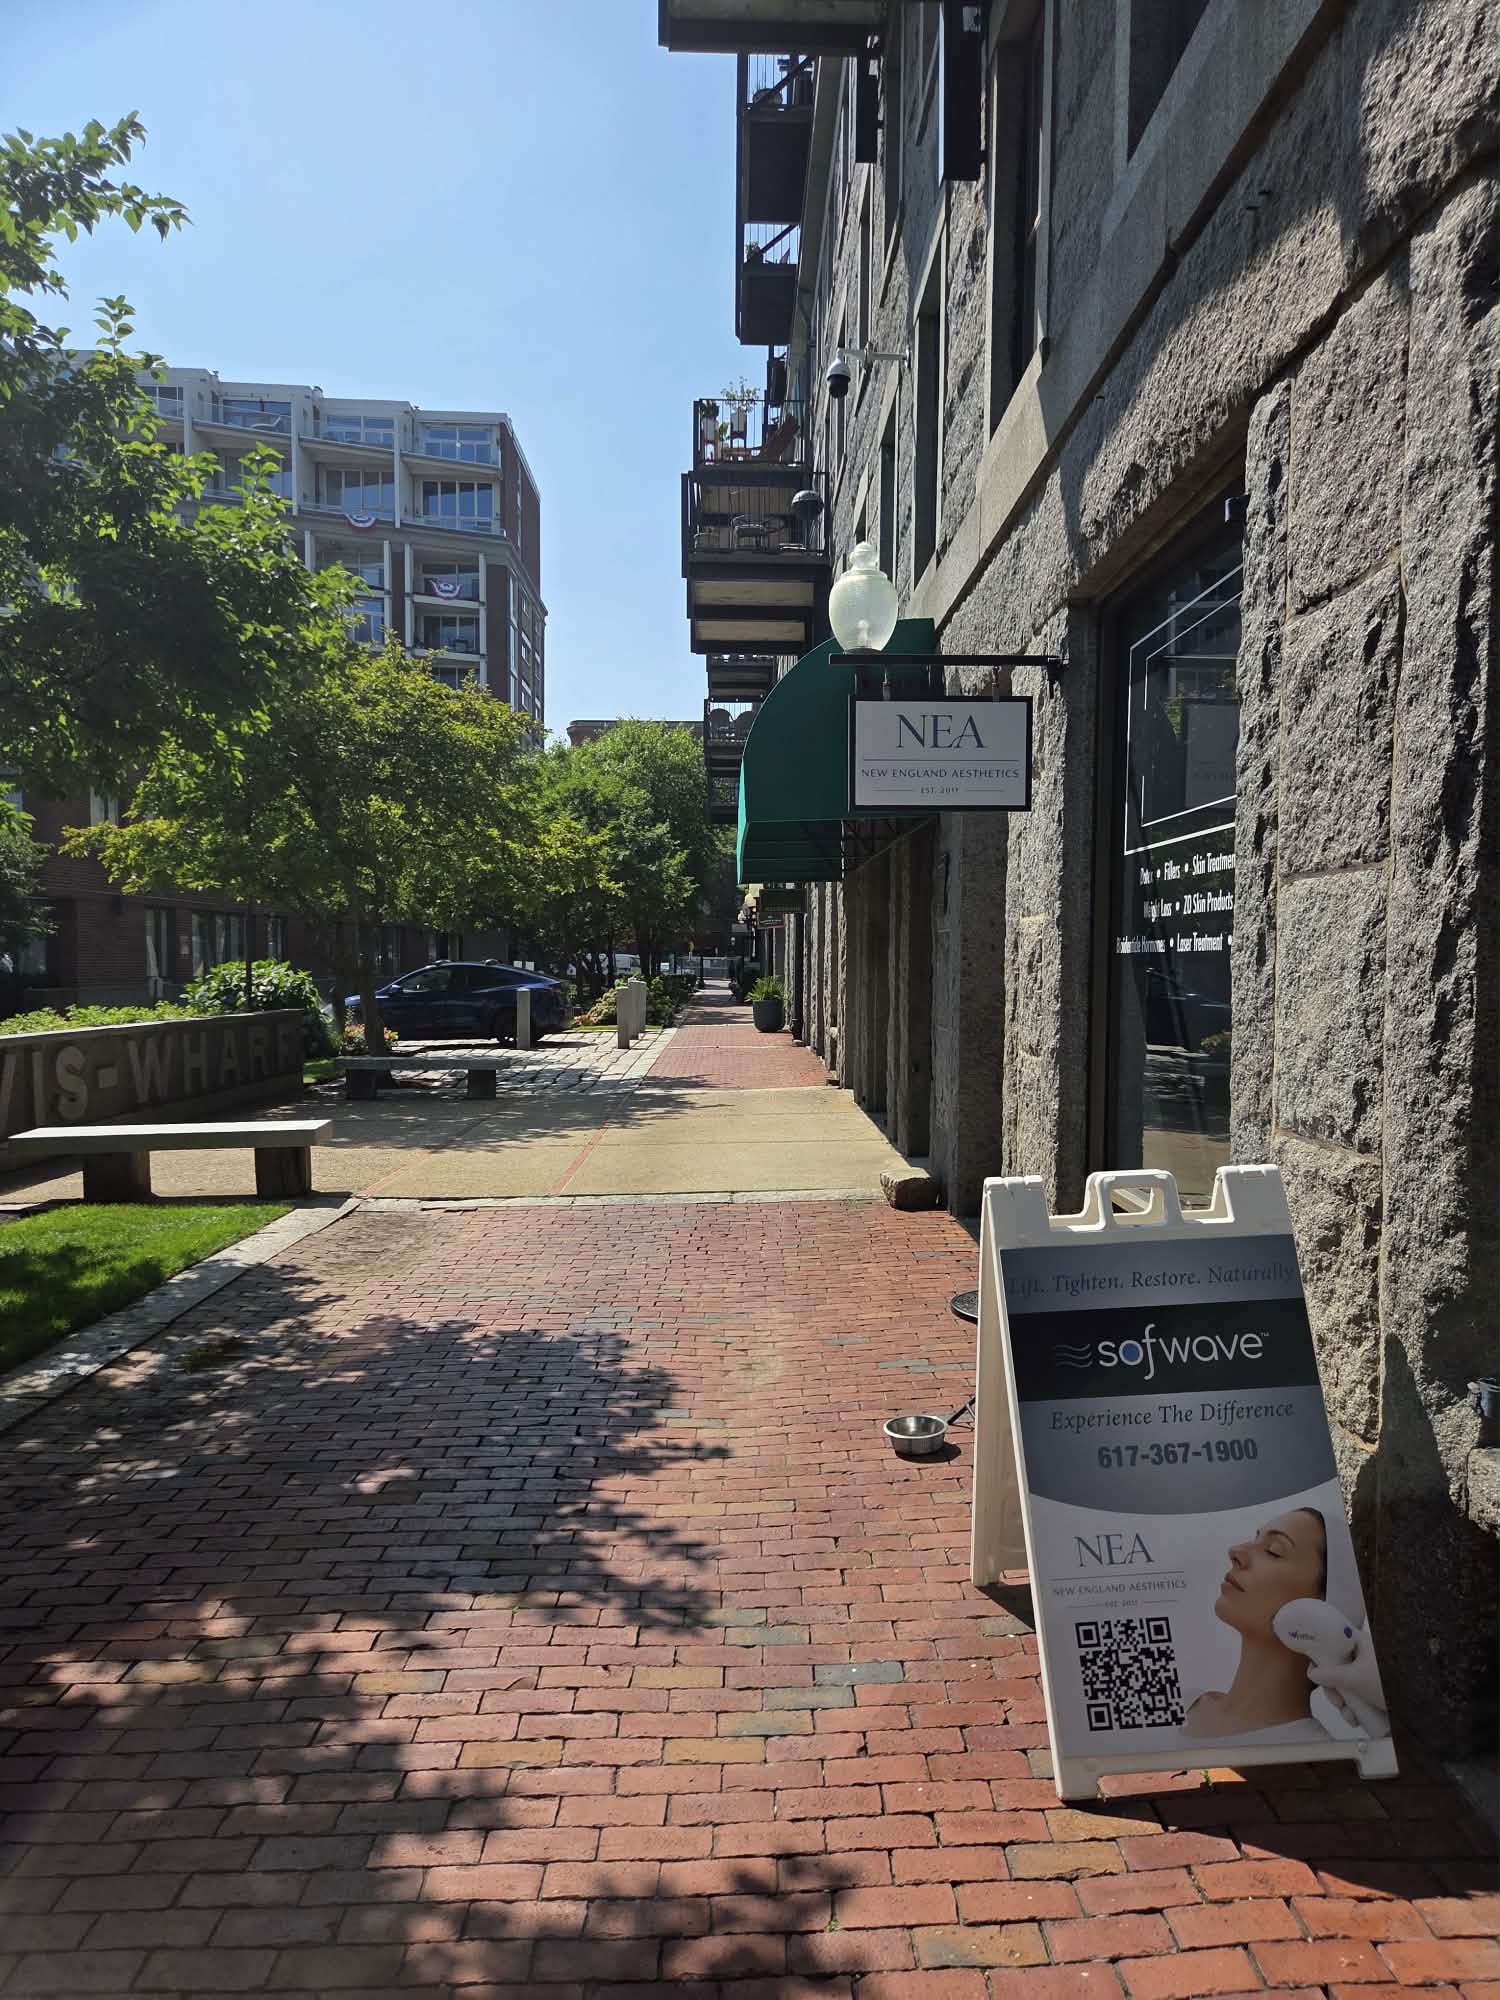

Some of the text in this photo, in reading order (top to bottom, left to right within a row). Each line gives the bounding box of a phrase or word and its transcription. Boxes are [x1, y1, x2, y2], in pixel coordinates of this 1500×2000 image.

[896, 713, 987, 748] NEA
[862, 768, 1019, 778] NEW ENGLAND AESTHETICS
[1163, 860, 1180, 880] Fillers
[1192, 853, 1206, 875] Skin
[1207, 852, 1236, 873] Treatmen
[1161, 898, 1172, 917] Loss
[1193, 892, 1206, 913] Skin
[1207, 889, 1234, 912] Products
[1176, 932, 1192, 952] Laser
[1193, 931, 1223, 952] Treatment
[1053, 1271, 1124, 1297] Tighten.
[1131, 1270, 1201, 1289] Restore.
[1050, 1401, 1295, 1433] Experience The Difference
[1097, 1438, 1258, 1469] 617-367-1900
[1073, 1533, 1155, 1567] NEA
[1078, 1583, 1126, 1595] ENGLAND
[1128, 1579, 1188, 1592] AESTHETICS
